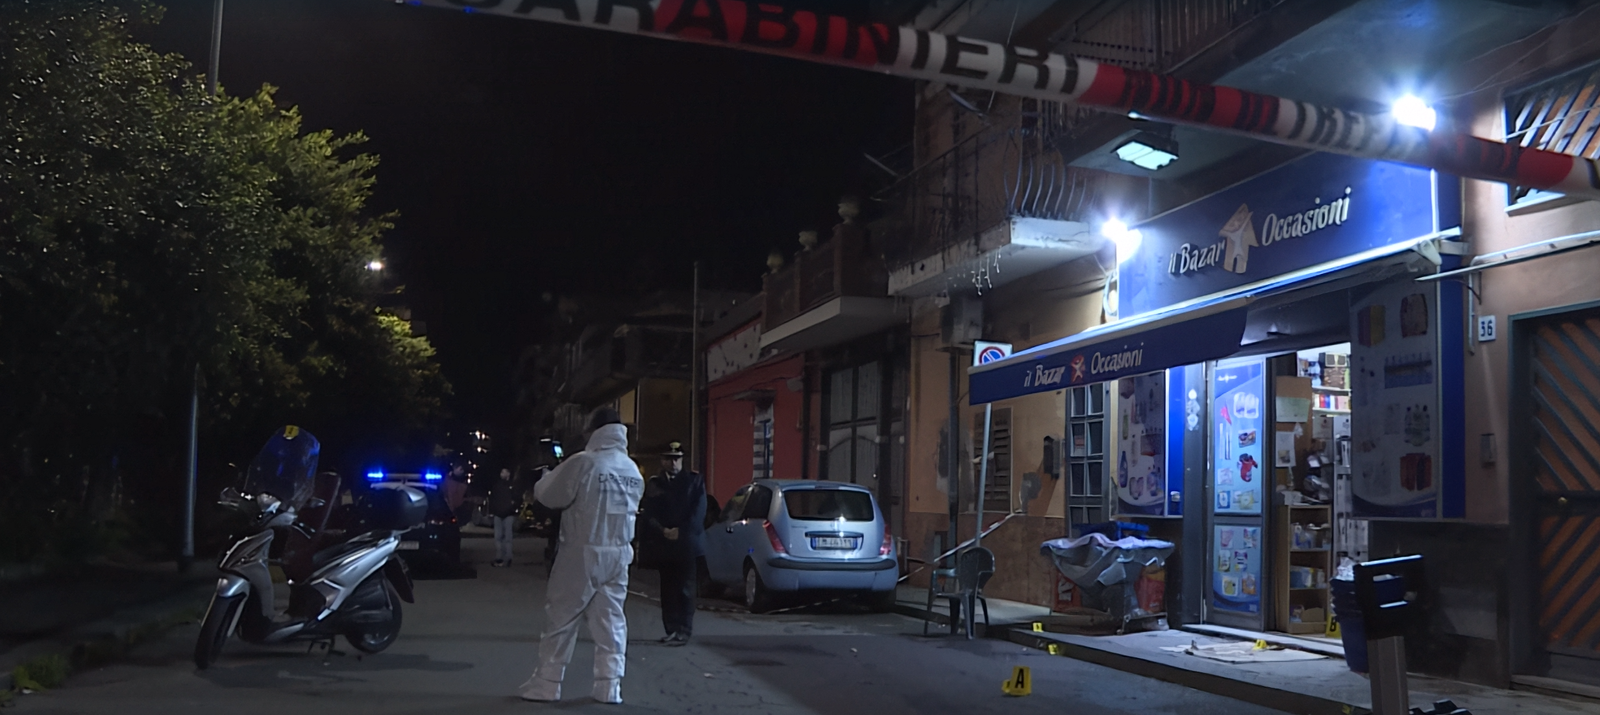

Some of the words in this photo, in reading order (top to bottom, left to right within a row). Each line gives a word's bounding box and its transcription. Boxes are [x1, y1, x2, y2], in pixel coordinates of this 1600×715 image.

[447, 0, 1079, 94] RABINIERI
[1180, 242, 1226, 274] Bazar
[1261, 186, 1352, 246] Occasioni
[1034, 364, 1066, 387] Bazar
[1090, 341, 1145, 375] Occasioni
[1014, 668, 1025, 689] A
